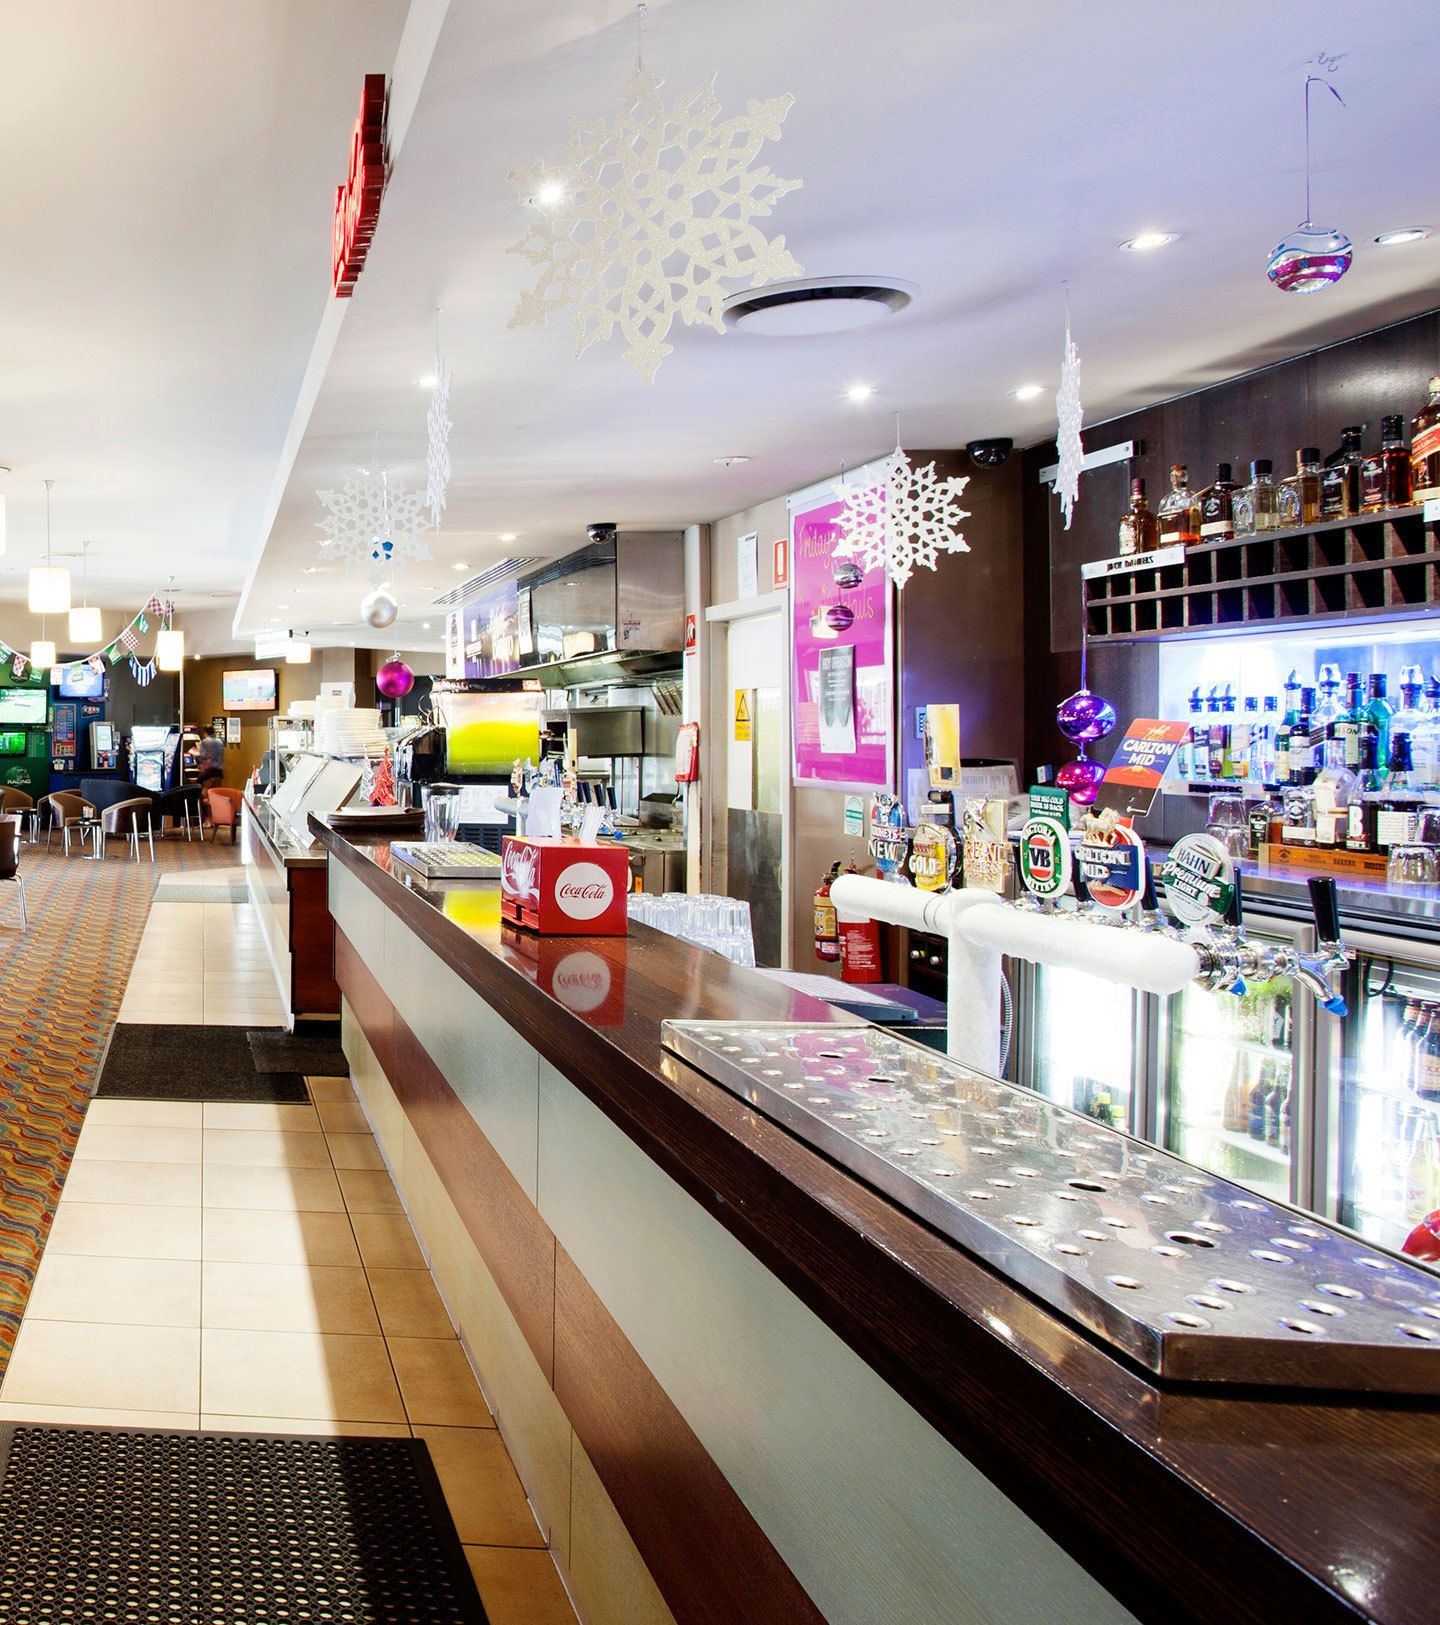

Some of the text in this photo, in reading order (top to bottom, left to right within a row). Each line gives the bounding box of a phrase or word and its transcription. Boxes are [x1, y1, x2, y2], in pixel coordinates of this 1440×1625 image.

[1122, 739, 1176, 755] CARLTON
[1128, 752, 1155, 766] MID
[1022, 823, 1057, 844] VICTORIA
[867, 839, 898, 861] NEW
[1029, 847, 1051, 867] VB
[909, 855, 937, 875] GOLD
[1176, 849, 1211, 875] HAHN
[1162, 861, 1221, 898] Premium
[1173, 878, 1198, 897] LIGHT
[559, 882, 607, 899] Coca-Cola
